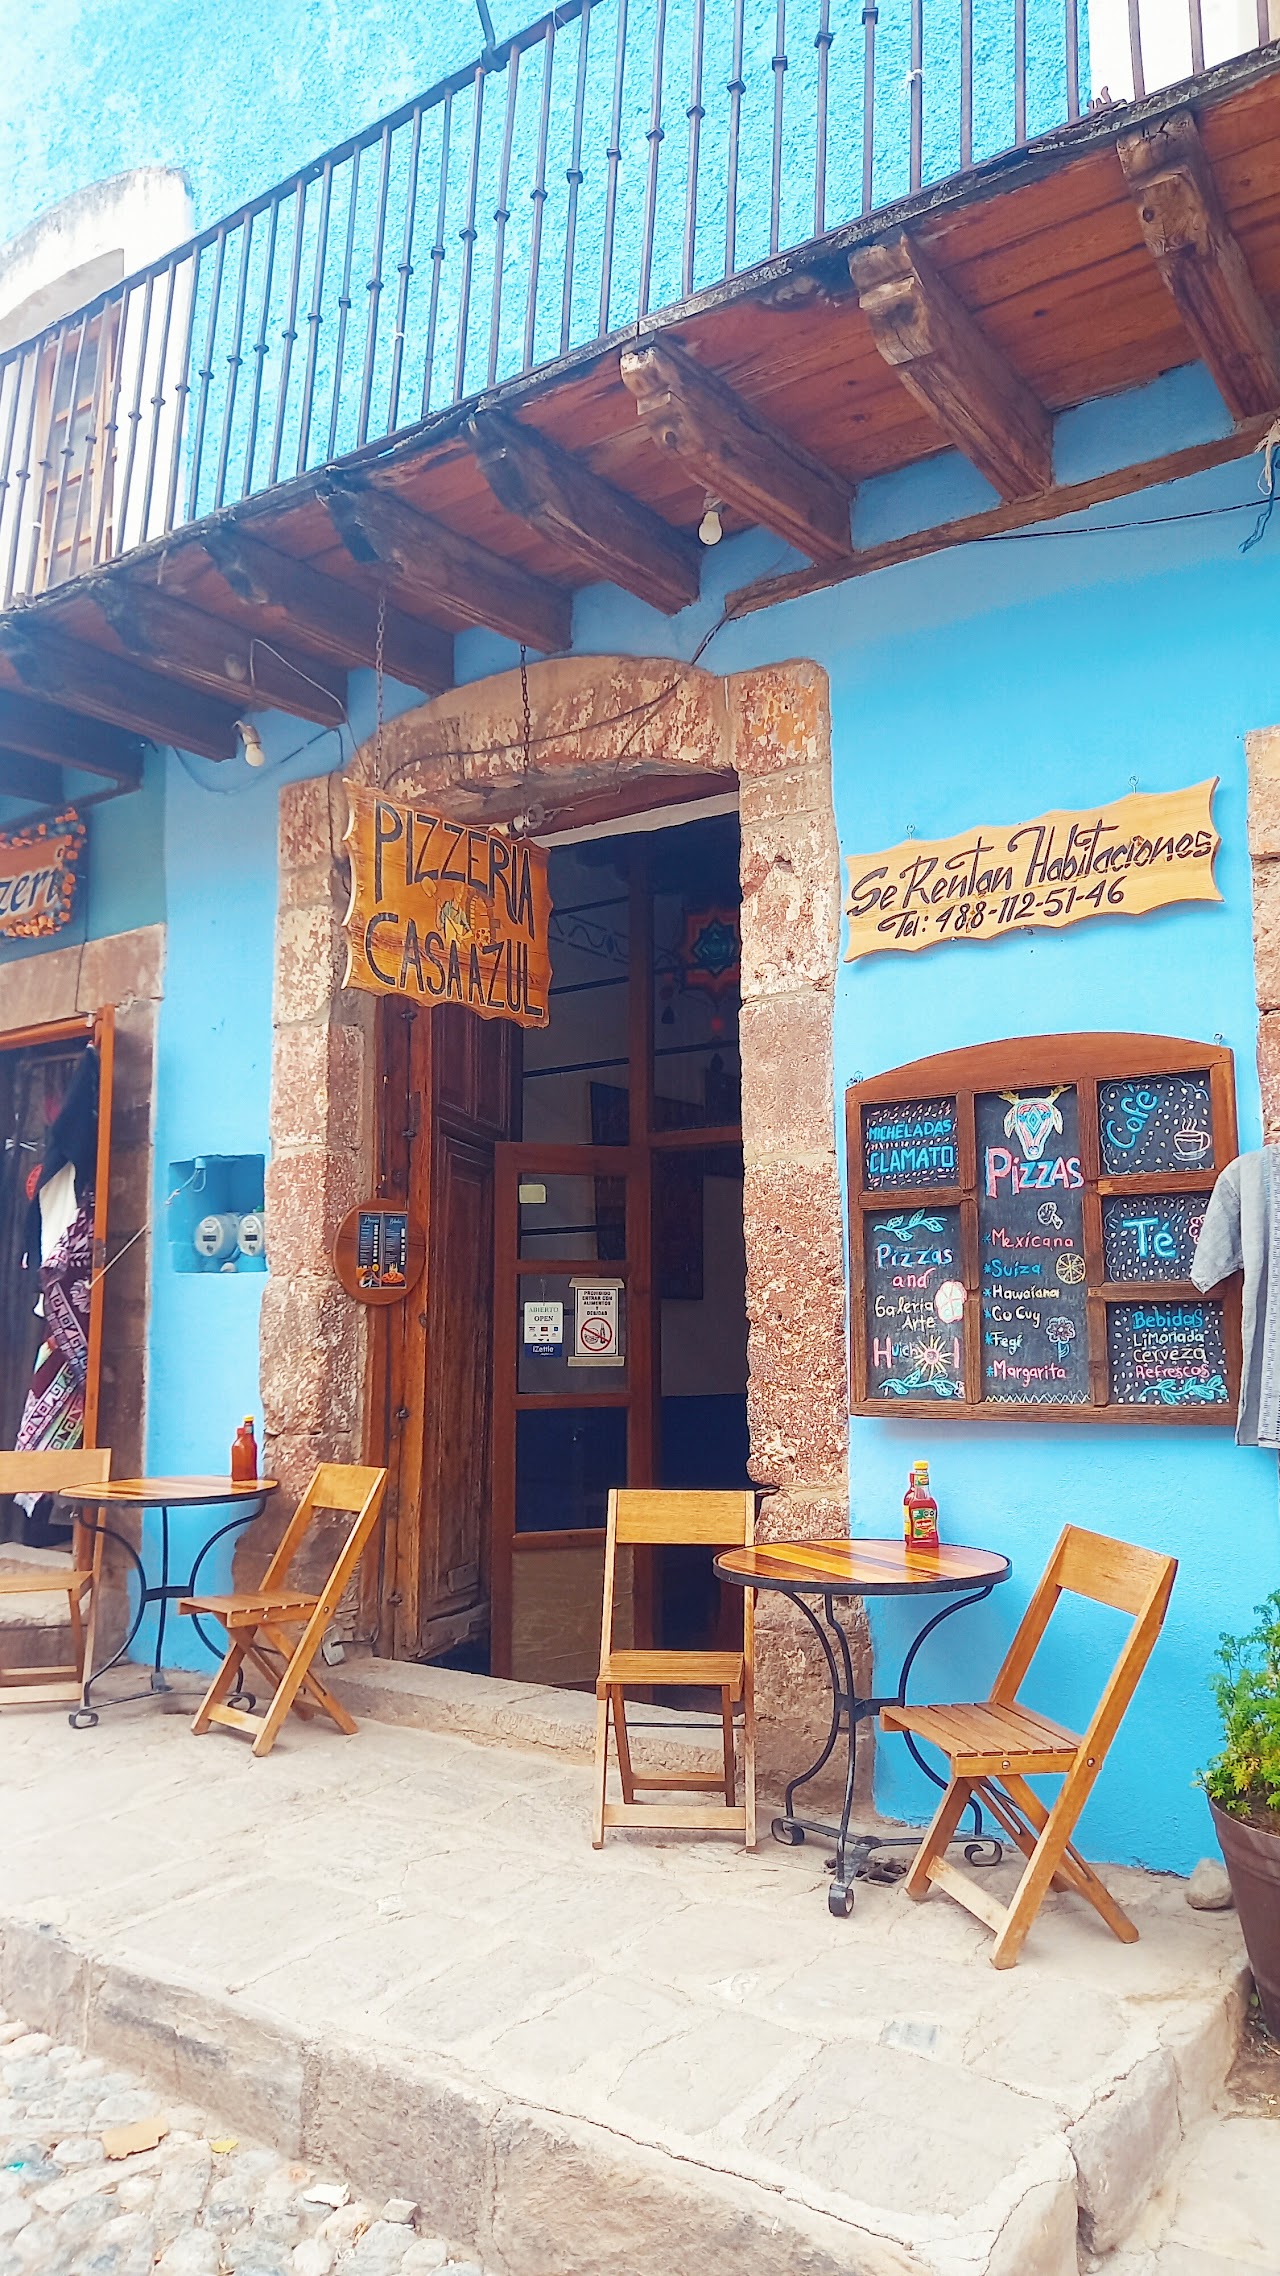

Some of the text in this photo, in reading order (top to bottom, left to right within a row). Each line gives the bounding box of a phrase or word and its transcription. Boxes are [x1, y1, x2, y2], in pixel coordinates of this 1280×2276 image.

[374, 799, 536, 941] PIZZERIA
[847, 819, 1214, 917] Se Rentan Habitaciones
[877, 875, 1125, 939] Tel: 488-112-51-46
[364, 912, 544, 1017] CASA AZUL
[869, 1119, 952, 1141] MICHELADAS
[1106, 1083, 1159, 1149] Café
[869, 1146, 954, 1174] CLAMATO
[1122, 1217, 1177, 1258] Té
[876, 1243, 953, 1269] Pizzas
[892, 1267, 937, 1289] and
[902, 1314, 937, 1333] Arte
[1132, 1308, 1204, 1330] Bebidas
[993, 1359, 1067, 1388] Margarita
[1135, 1363, 1211, 1380] Refrescos
